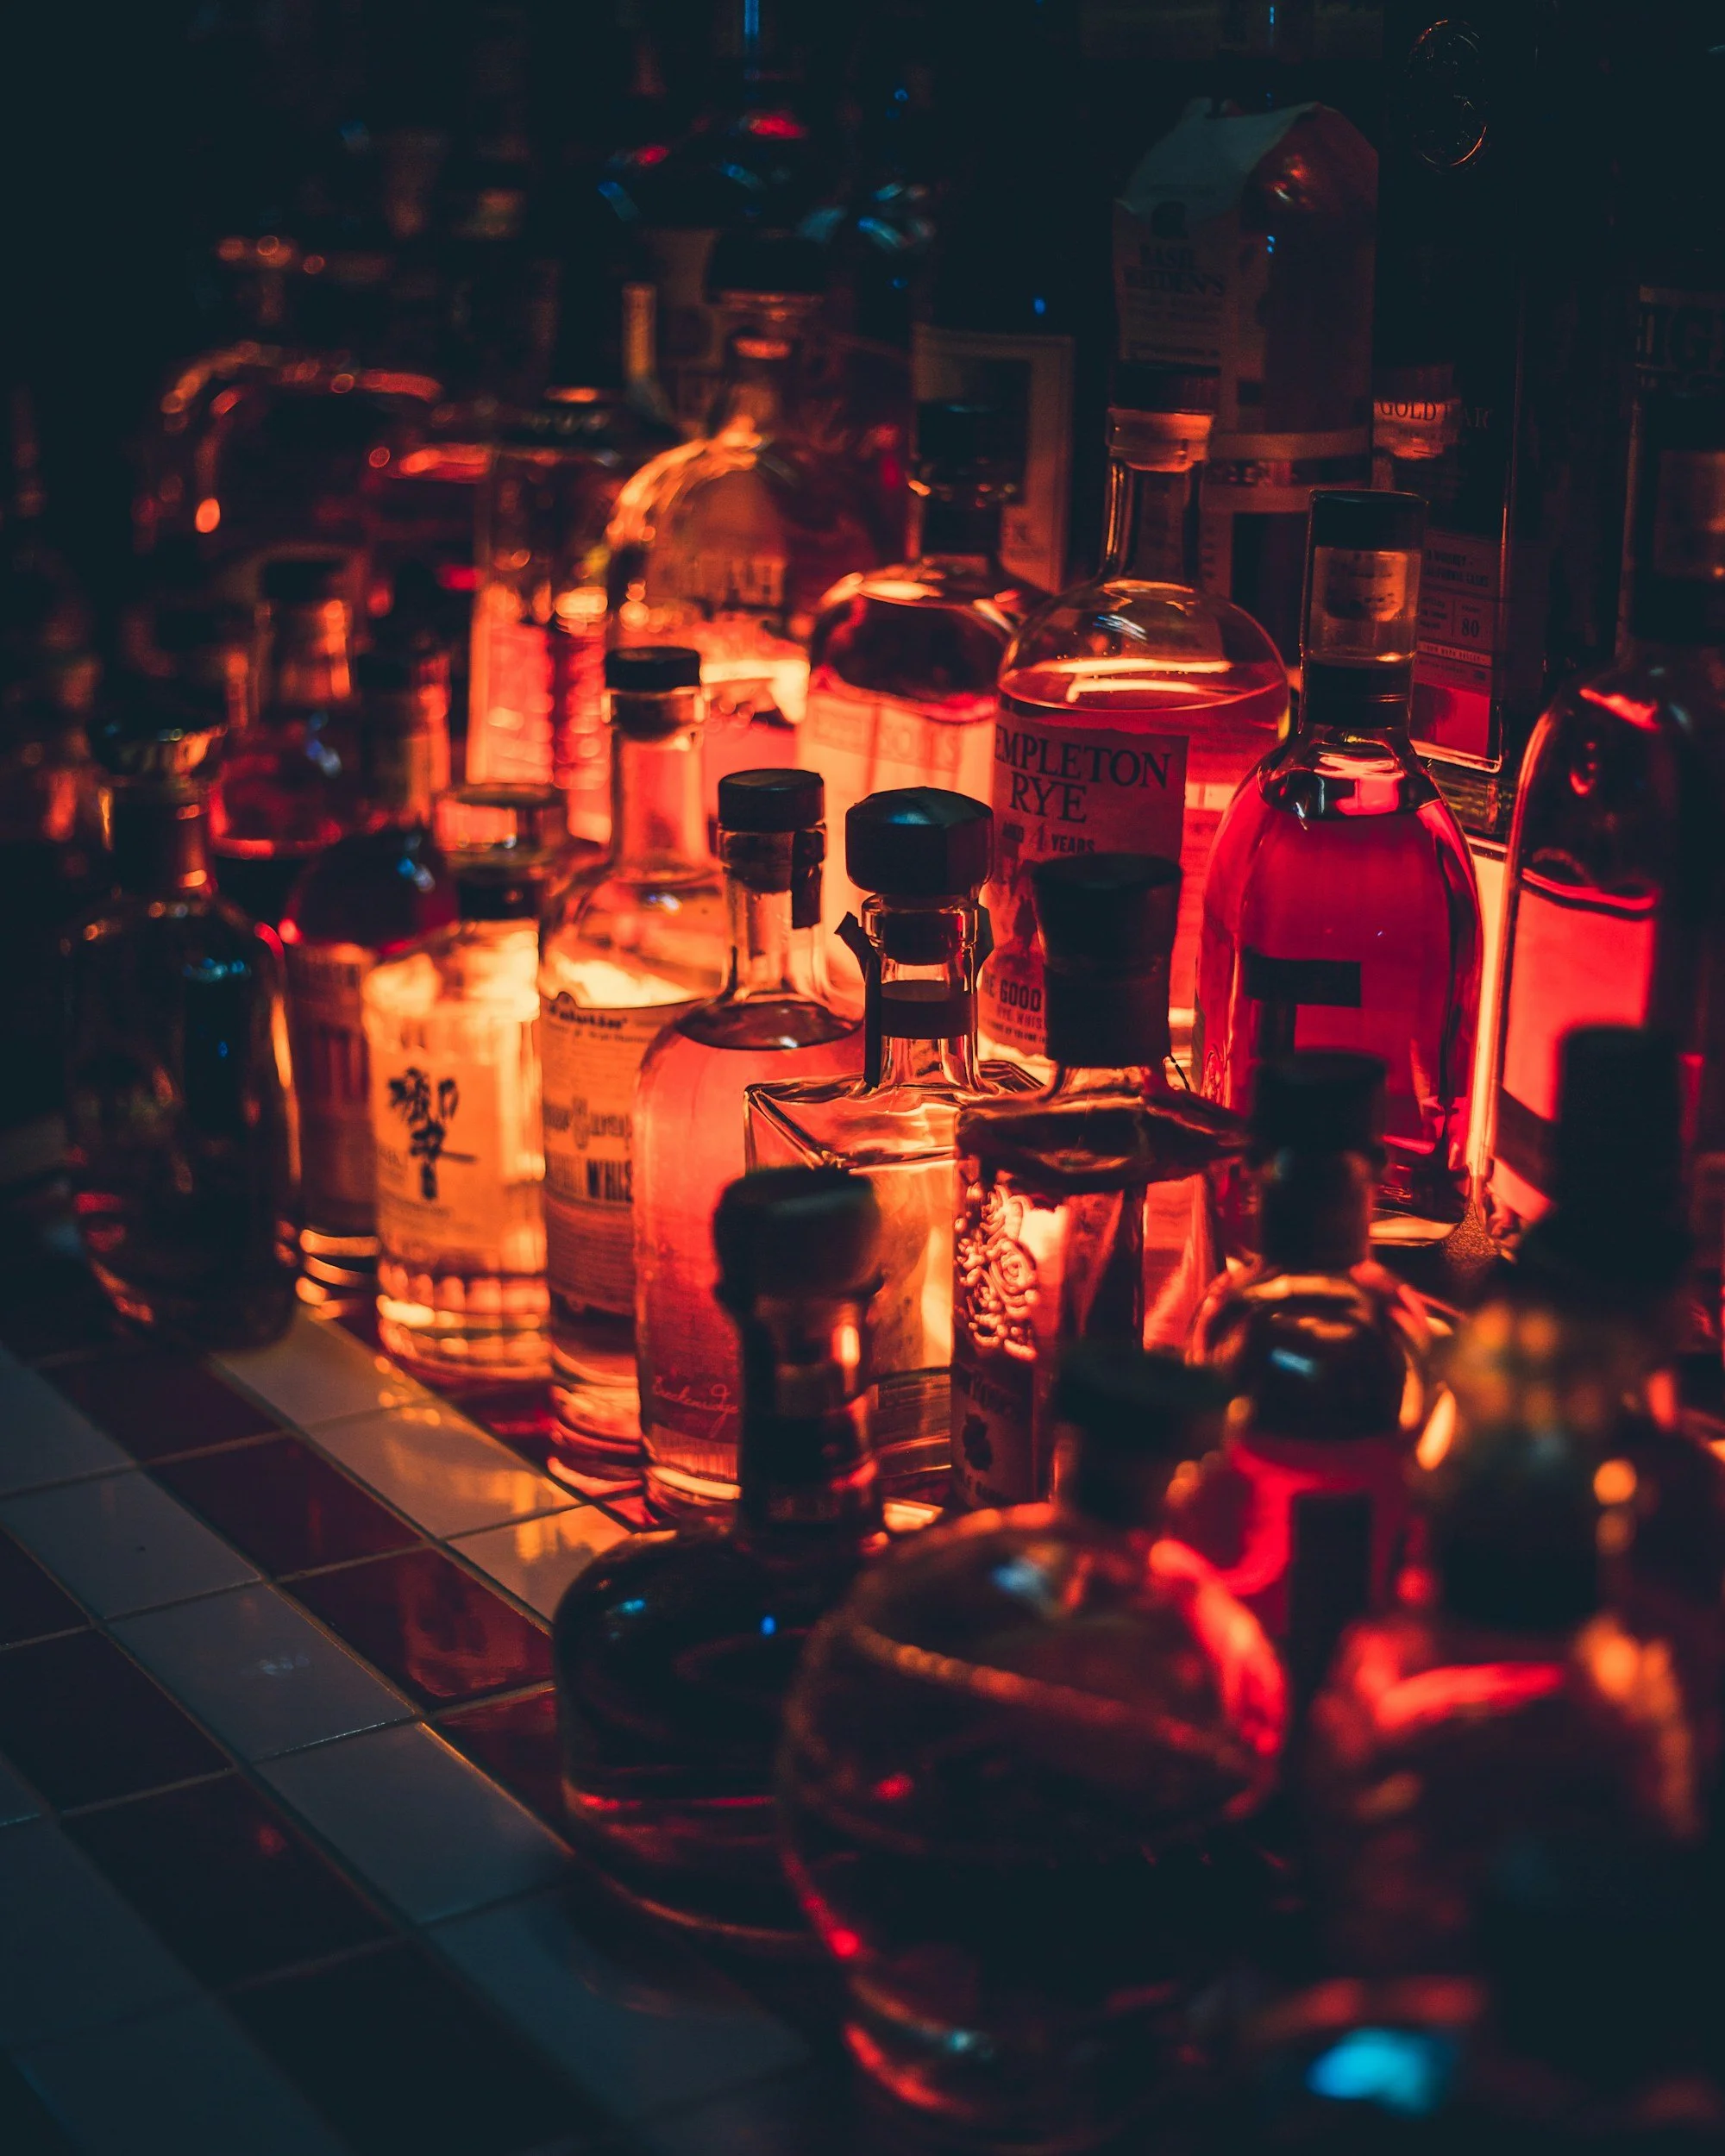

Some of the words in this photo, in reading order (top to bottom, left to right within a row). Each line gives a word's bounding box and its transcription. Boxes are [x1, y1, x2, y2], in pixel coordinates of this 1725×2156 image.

[1461, 617, 1481, 638] 80
[1010, 771, 1088, 824] RYE
[1051, 832, 1095, 855] YEARS
[1000, 979, 1041, 1012] GOOD
